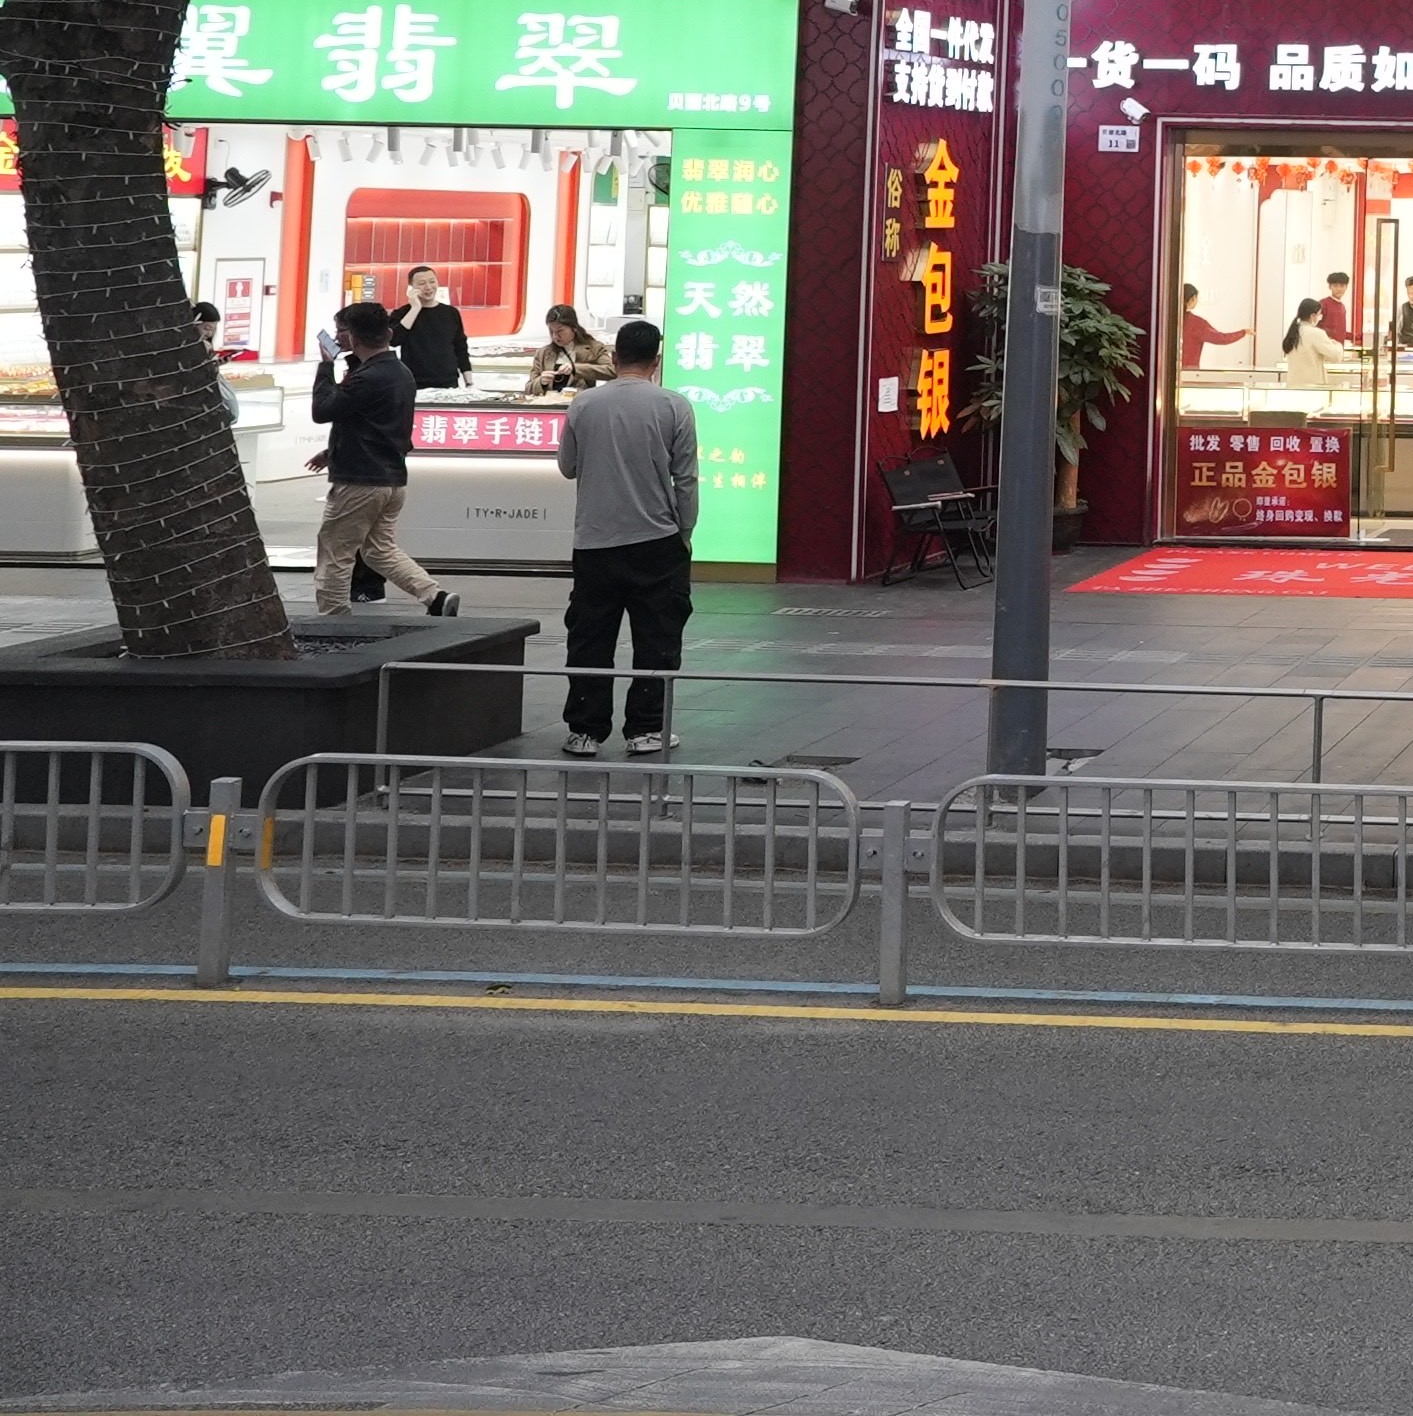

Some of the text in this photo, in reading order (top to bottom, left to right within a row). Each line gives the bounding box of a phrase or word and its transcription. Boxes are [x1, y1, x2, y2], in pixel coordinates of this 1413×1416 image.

[1109, 139, 1119, 148] 11
[884, 168, 903, 258] 俗称
[676, 280, 775, 319] 天然
[916, 137, 960, 440] 金包银
[675, 332, 770, 372] 翡翠
[1190, 434, 1341, 453] 批发 零售 回收 置换
[1190, 460, 1338, 489] 正品金包银
